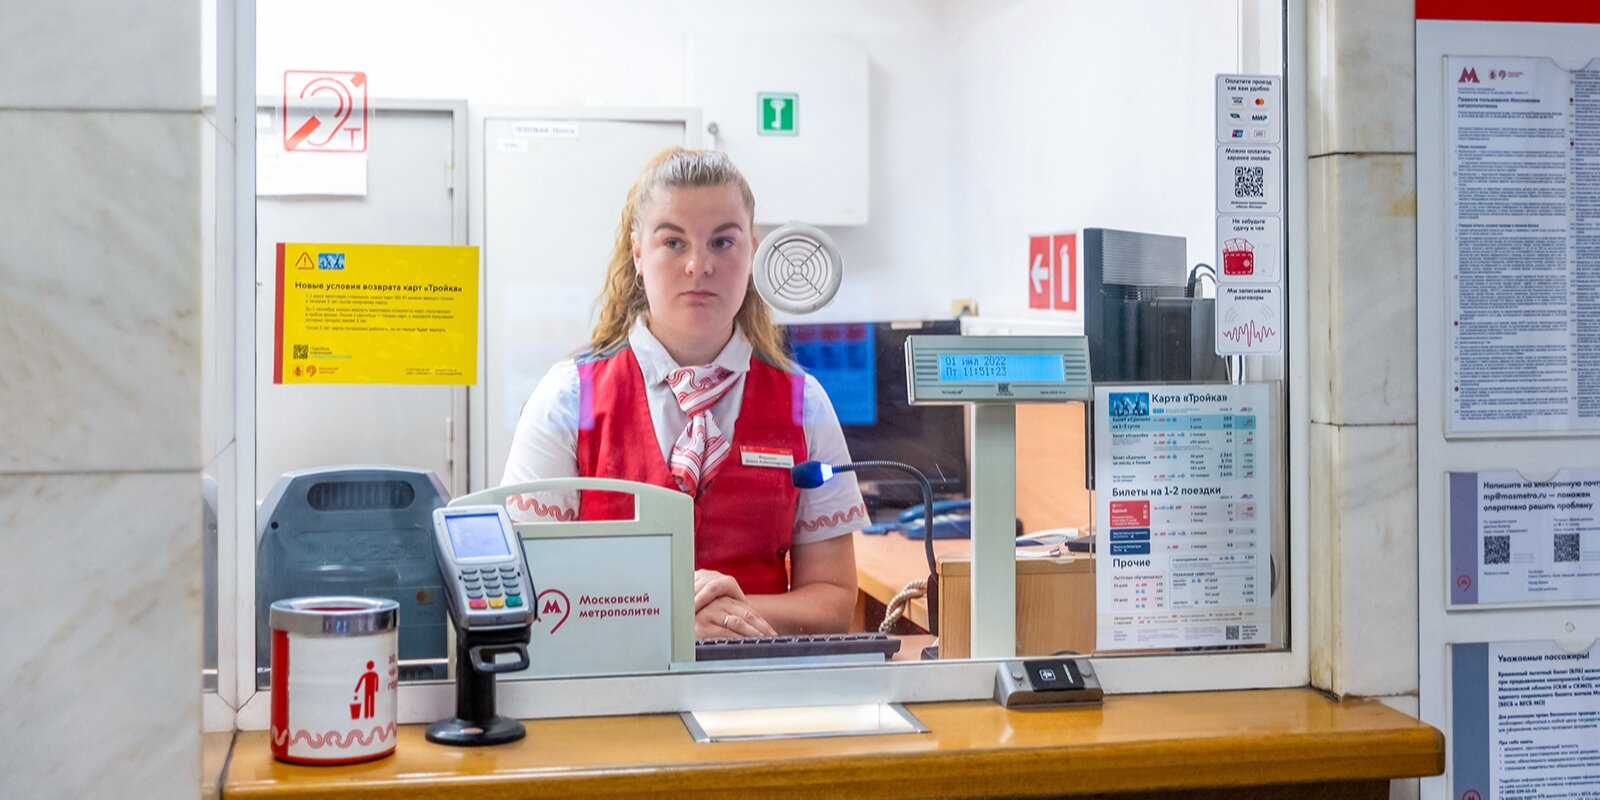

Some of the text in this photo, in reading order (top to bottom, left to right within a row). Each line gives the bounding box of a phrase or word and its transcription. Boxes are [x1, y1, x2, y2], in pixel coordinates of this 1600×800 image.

[1241, 218, 1265, 226] забудьте
[294, 281, 462, 293] Новые условия возврата карт «Тройка»
[945, 356, 956, 366] 01
[984, 356, 1007, 366] 2022
[945, 367, 1007, 377] Пт 11:51:23
[1152, 393, 1228, 404] Карта «Тройка»
[1483, 481, 1521, 489] Напишите
[1534, 480, 1581, 489] электронную
[1112, 485, 1221, 497] Билеты на 1-2 поездки
[1483, 490, 1591, 502] mp@mosmetro.ru поможем
[1483, 501, 1593, 512] оперативно решить проблему
[1112, 558, 1151, 569] Прочие
[579, 592, 650, 605] Московский
[579, 607, 660, 619] метрополитен
[1498, 652, 1590, 663] Уважаемые пассажиры!
